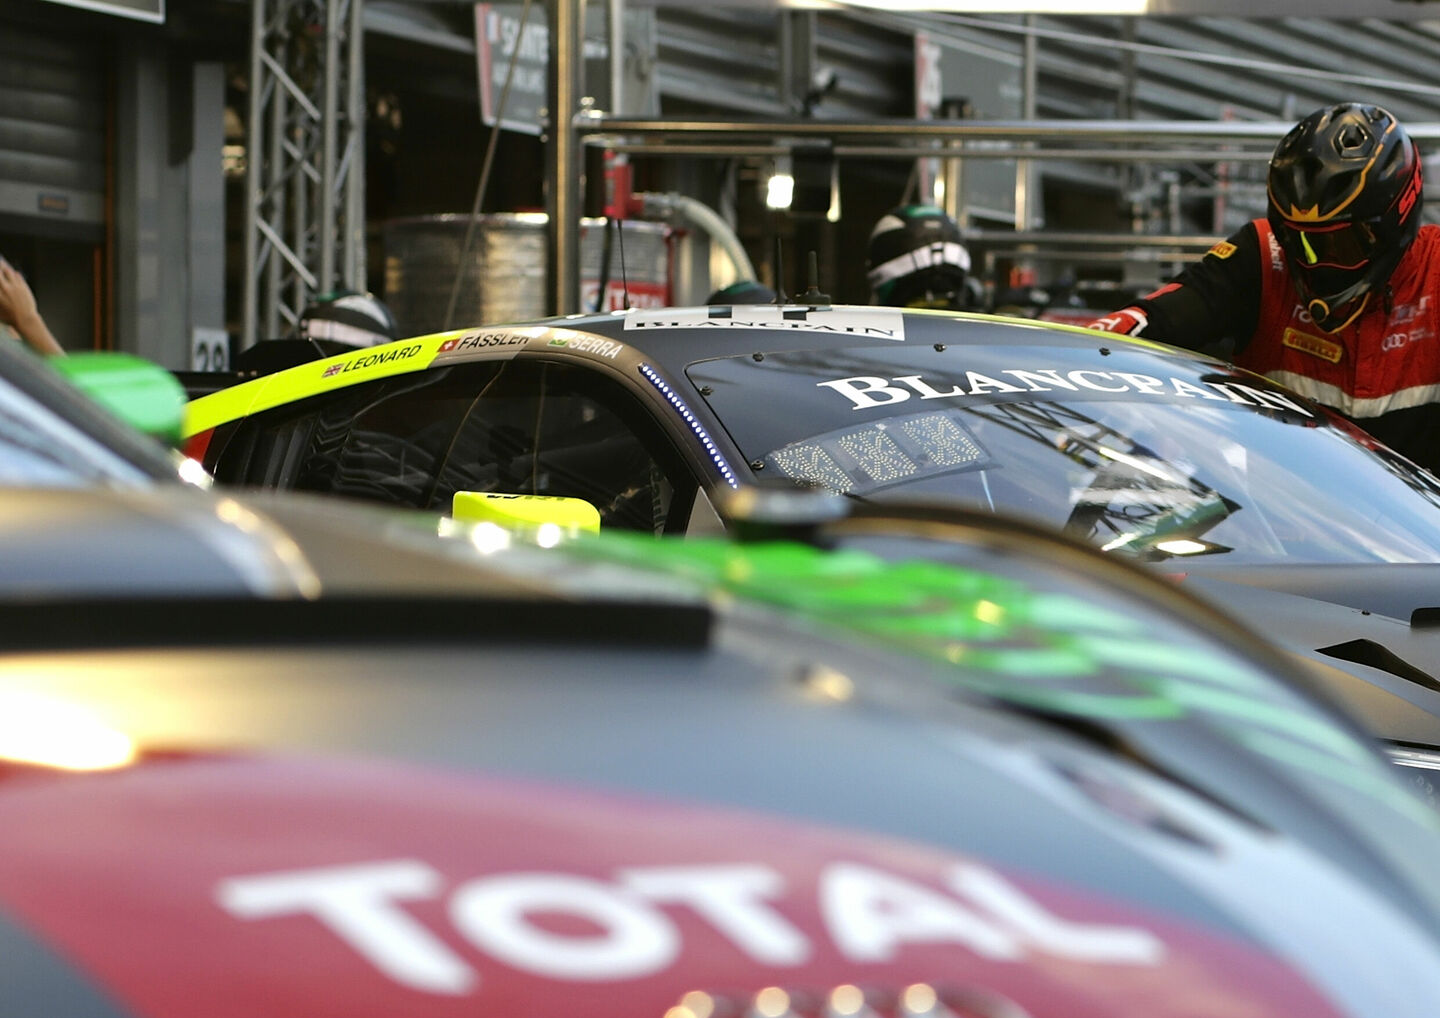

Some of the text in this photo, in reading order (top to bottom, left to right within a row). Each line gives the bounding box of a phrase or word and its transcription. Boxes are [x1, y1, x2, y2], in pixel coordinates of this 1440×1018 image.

[341, 344, 422, 374] LEONARD
[568, 333, 624, 360] SERRA
[818, 368, 1315, 419] BLANCPAIN
[213, 859, 1169, 996] TOTAL
